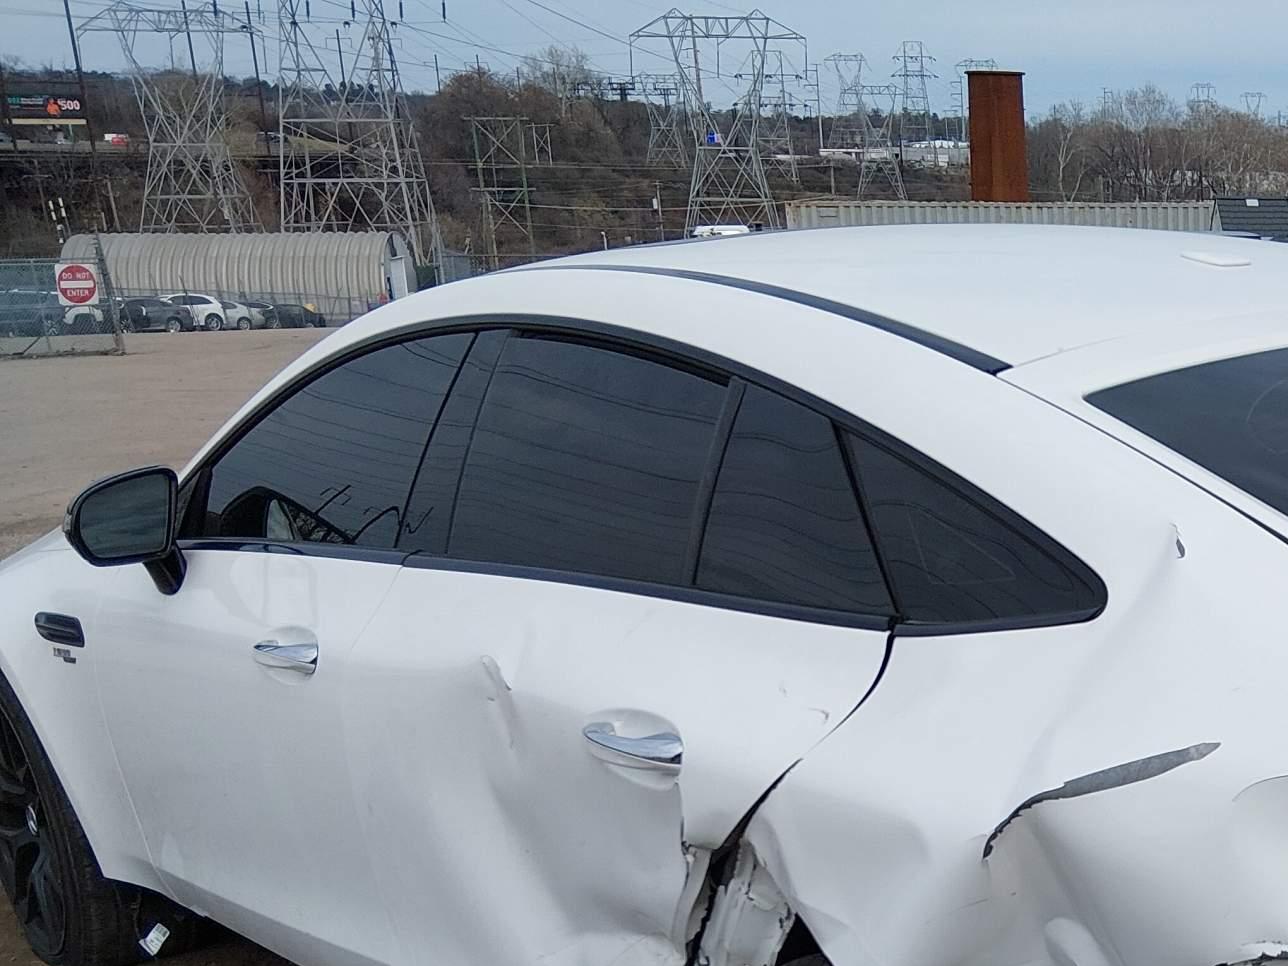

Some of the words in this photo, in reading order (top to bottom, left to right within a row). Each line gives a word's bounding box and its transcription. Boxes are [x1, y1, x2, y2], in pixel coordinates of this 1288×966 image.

[62, 272, 73, 280] DO
[76, 271, 90, 280] NOT
[66, 289, 90, 297] ENTER
